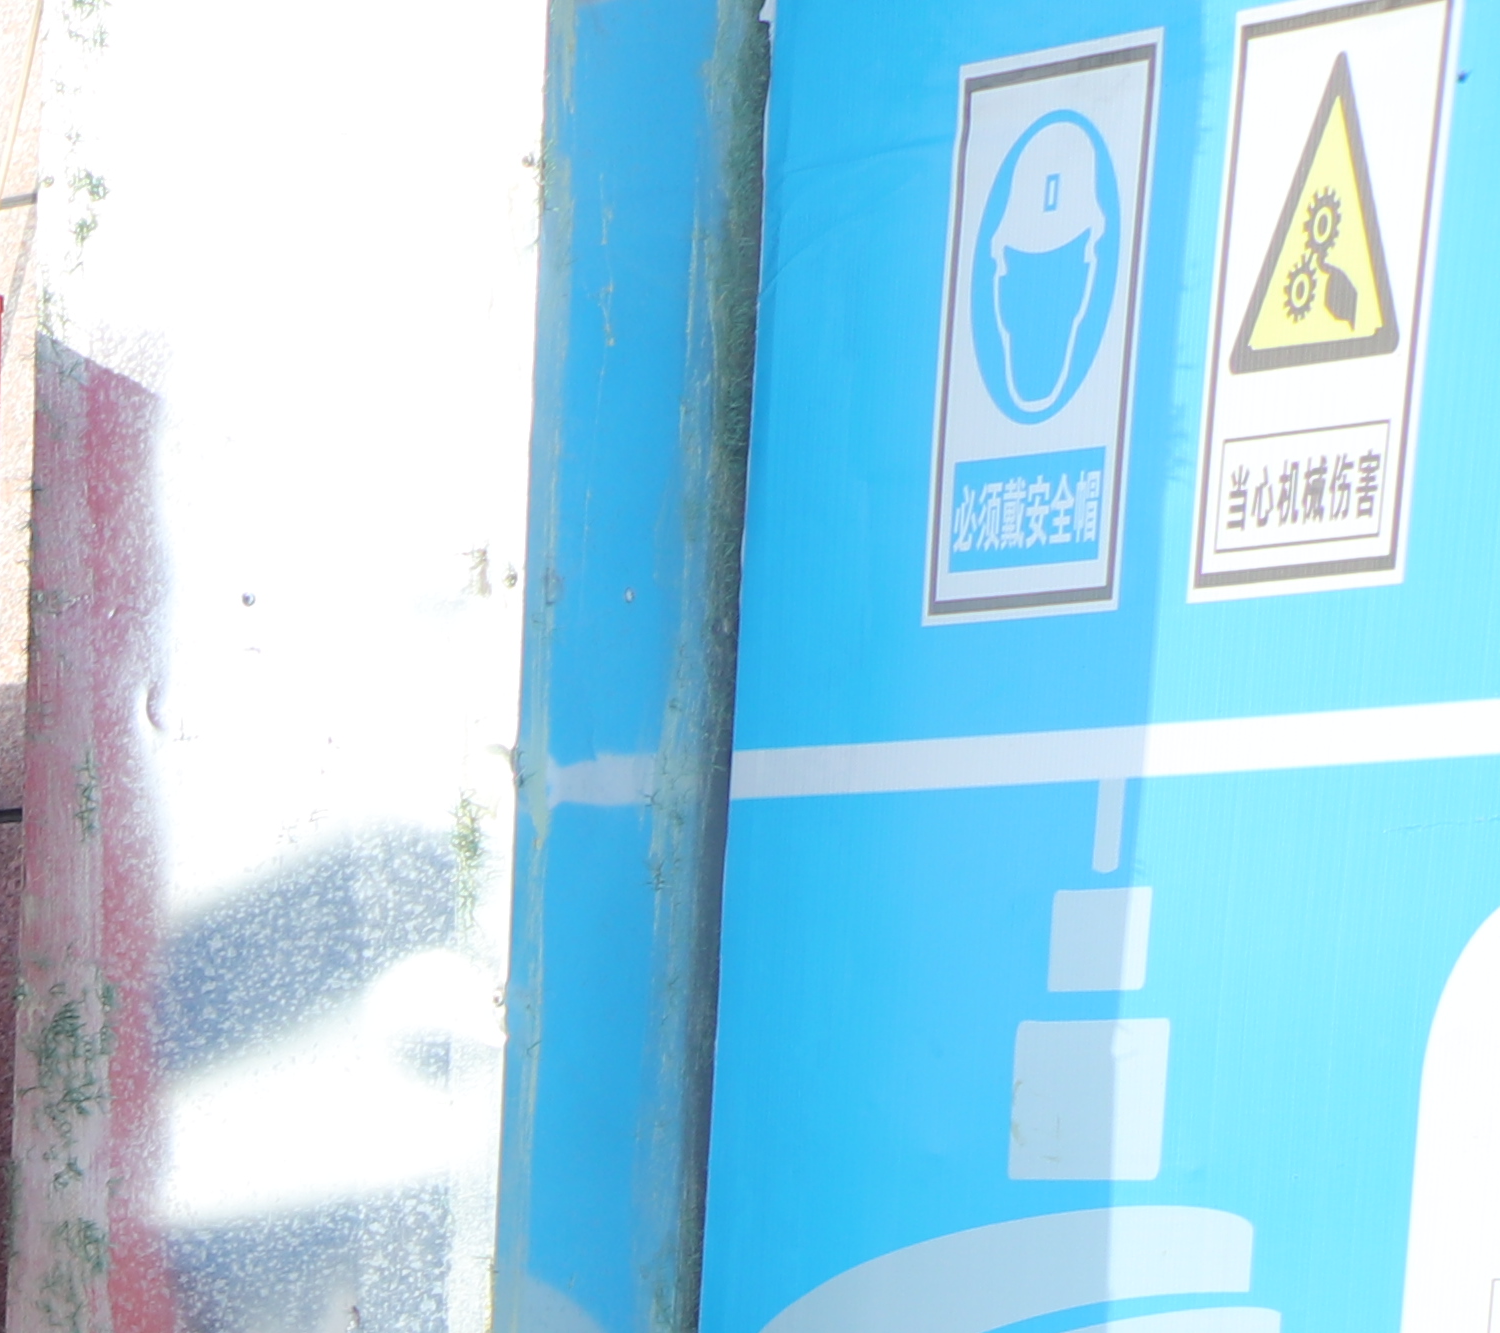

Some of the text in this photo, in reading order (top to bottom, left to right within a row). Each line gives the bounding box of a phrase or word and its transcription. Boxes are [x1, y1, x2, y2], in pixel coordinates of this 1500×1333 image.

[953, 470, 1102, 553] 必须戴安全帽
[1226, 448, 1382, 532] 当心机械伤害
